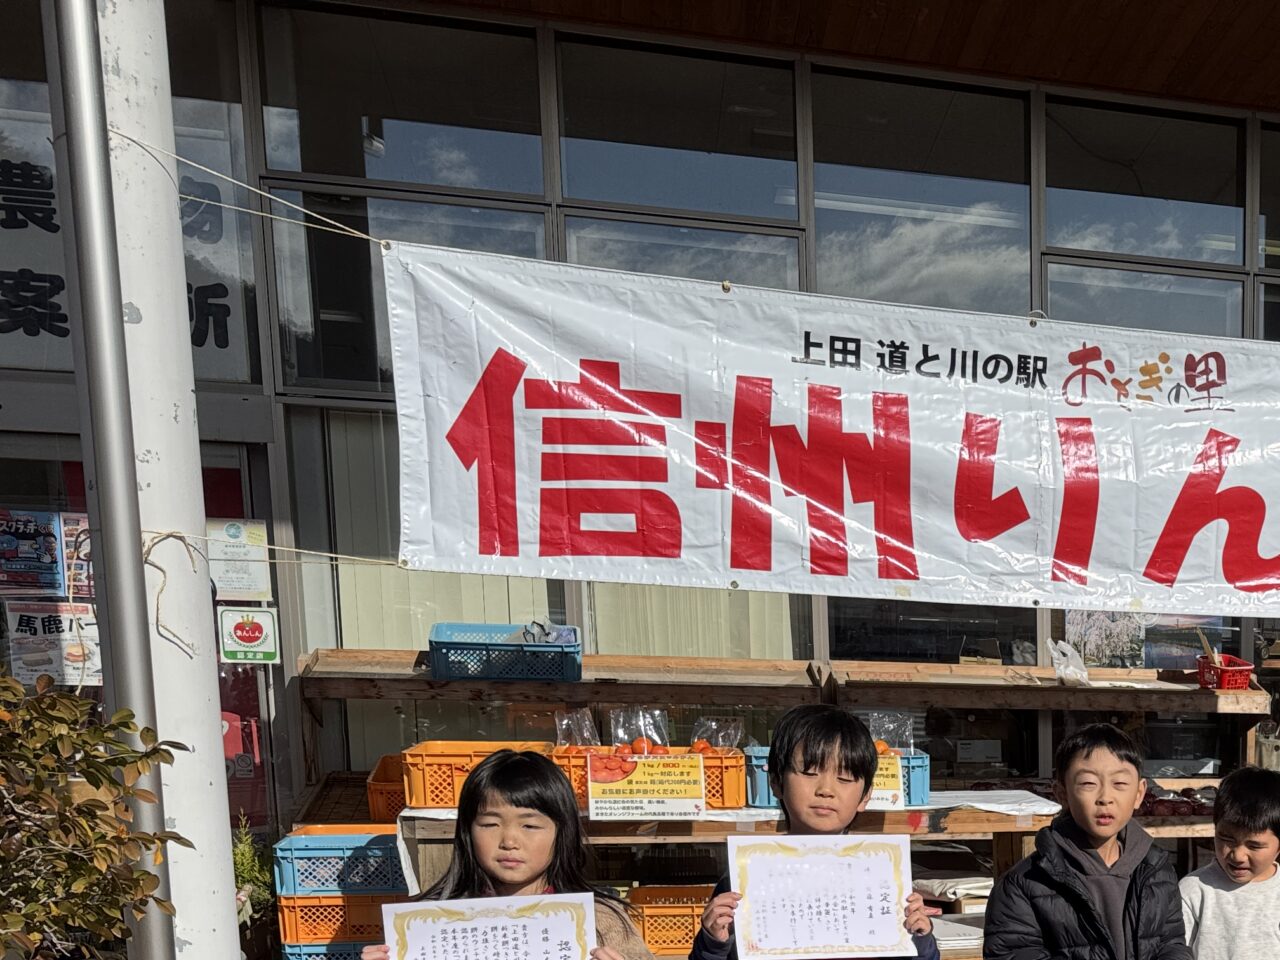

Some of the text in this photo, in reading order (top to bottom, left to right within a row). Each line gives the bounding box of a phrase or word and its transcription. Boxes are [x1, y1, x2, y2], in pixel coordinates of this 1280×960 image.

[791, 330, 1236, 413] 上田 道と川の駅 おとぎの里
